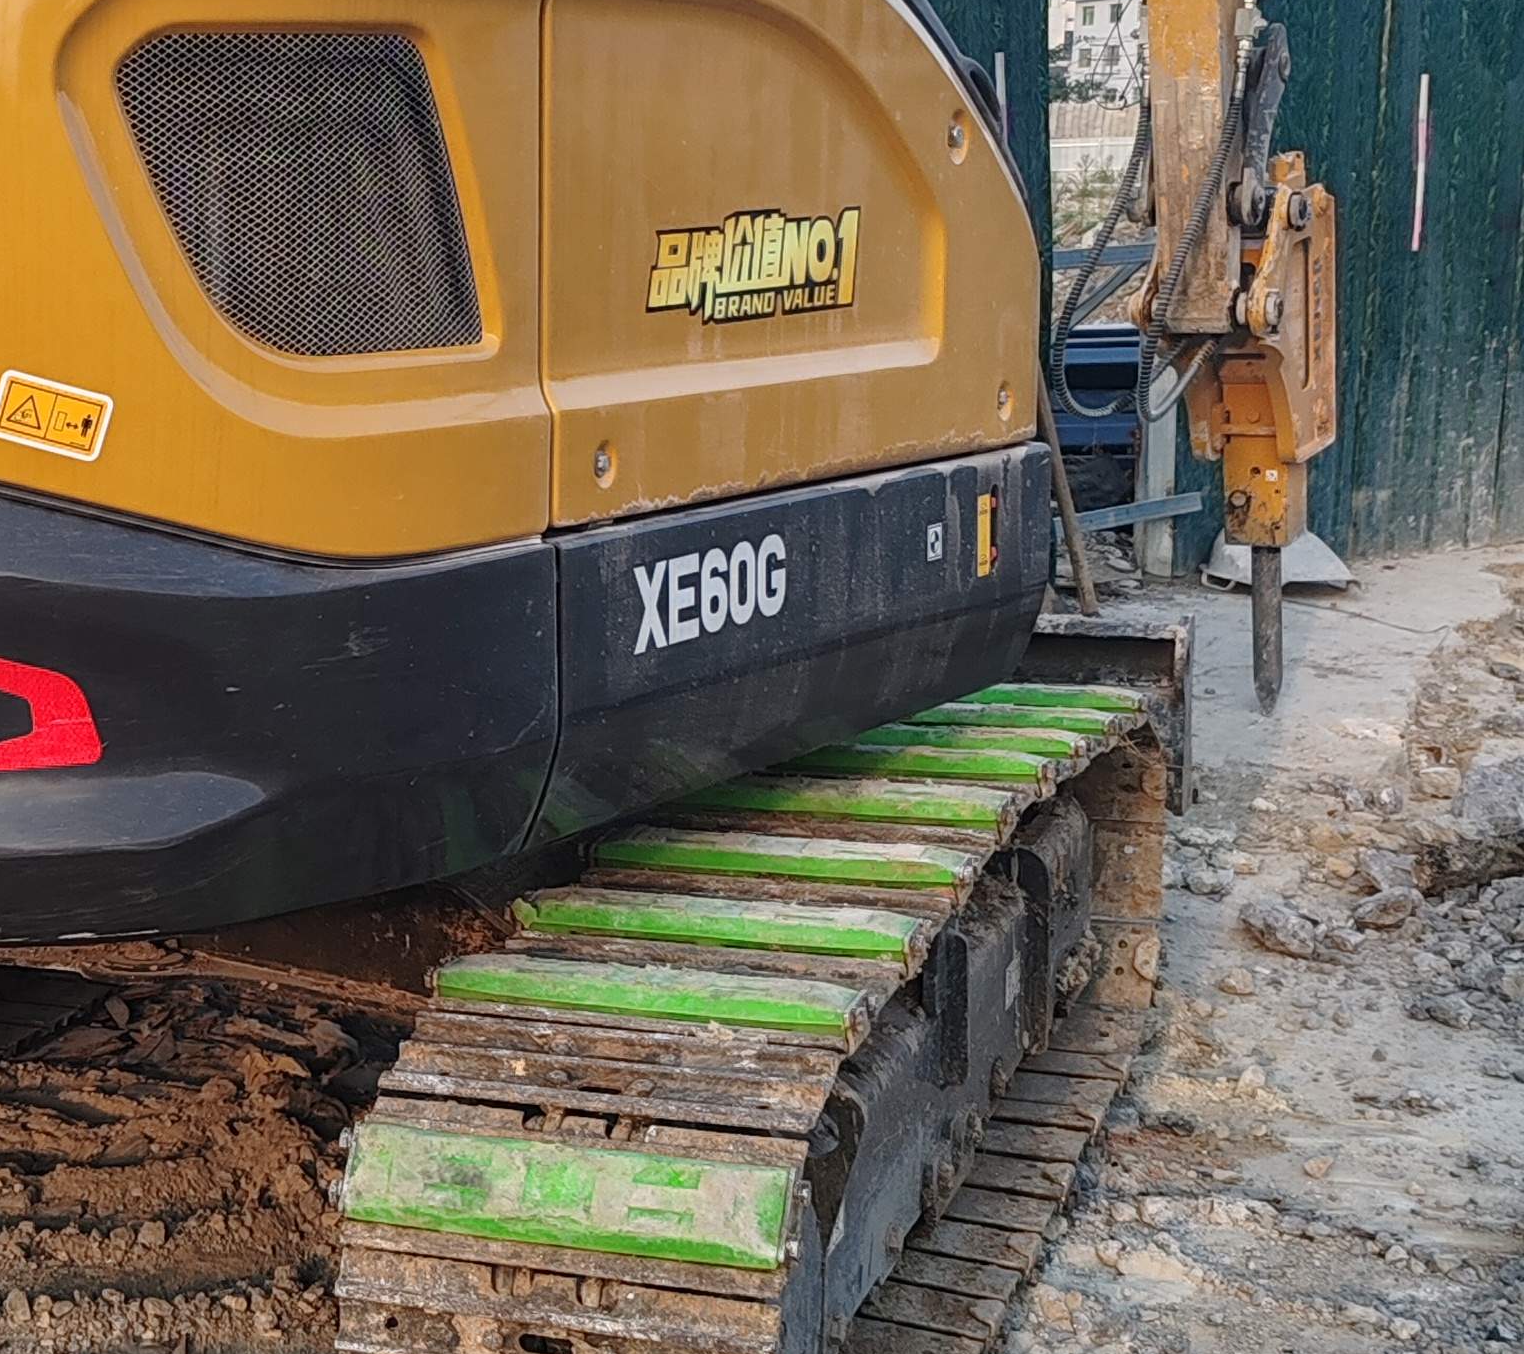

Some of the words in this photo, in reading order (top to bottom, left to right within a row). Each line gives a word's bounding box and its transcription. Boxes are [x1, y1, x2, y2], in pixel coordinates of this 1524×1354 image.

[713, 291, 776, 320] BRAND
[781, 284, 836, 311] VALUE
[633, 534, 787, 656] XE60G
